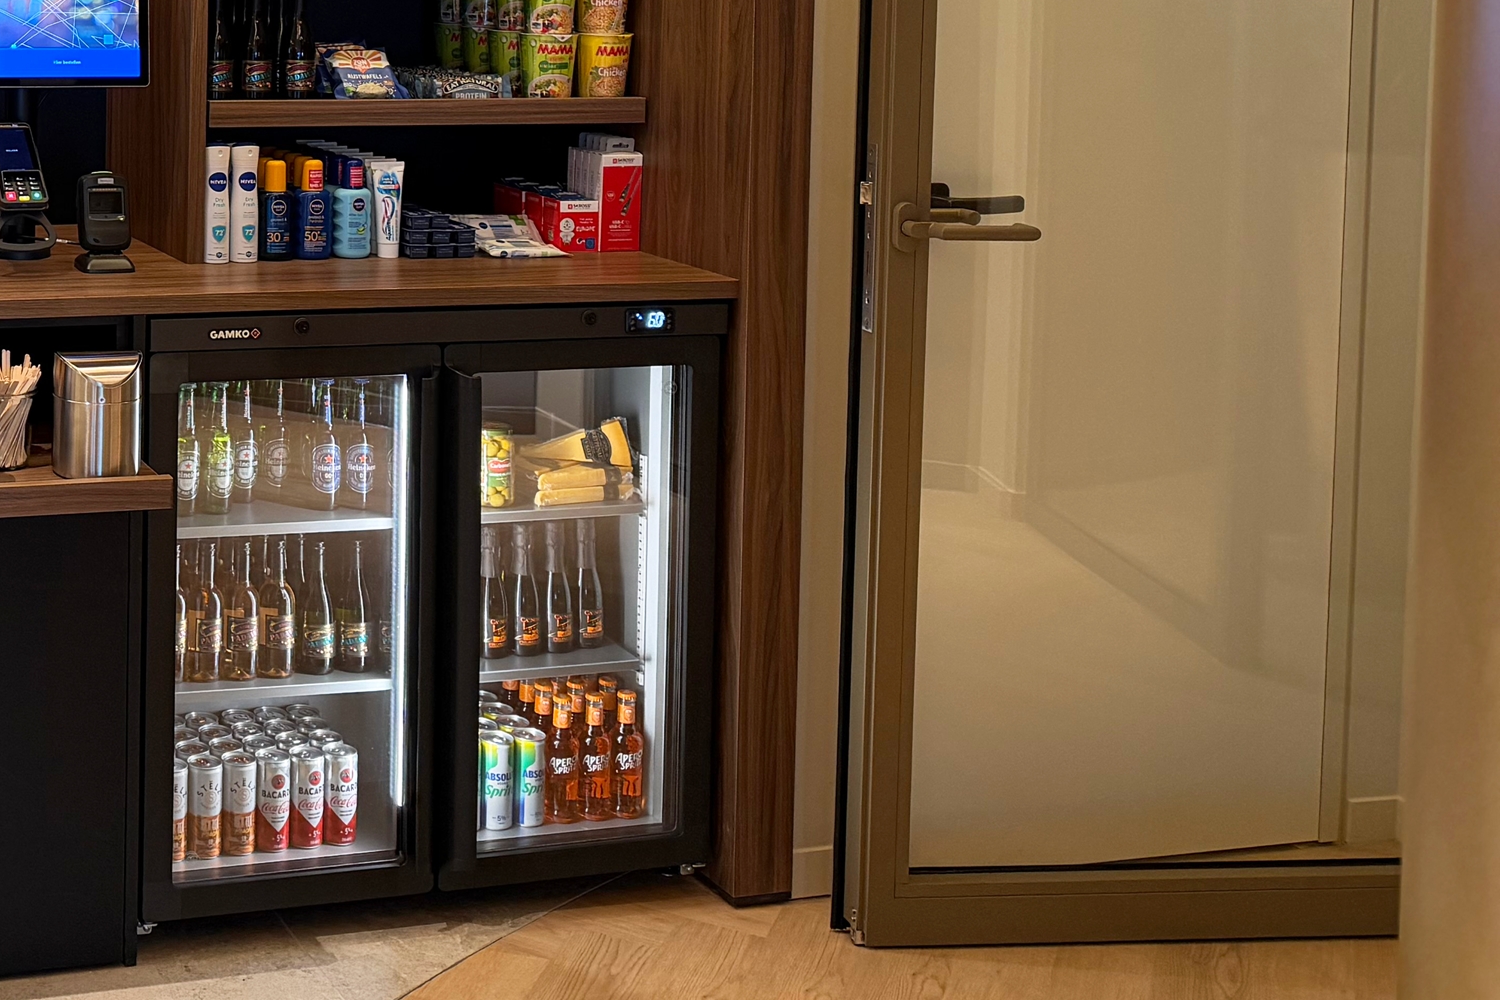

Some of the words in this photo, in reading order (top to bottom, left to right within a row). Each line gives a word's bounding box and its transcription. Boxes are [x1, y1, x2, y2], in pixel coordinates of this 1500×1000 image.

[537, 44, 573, 55] MAMA
[267, 232, 281, 242] 30
[209, 328, 250, 339] GAMKO
